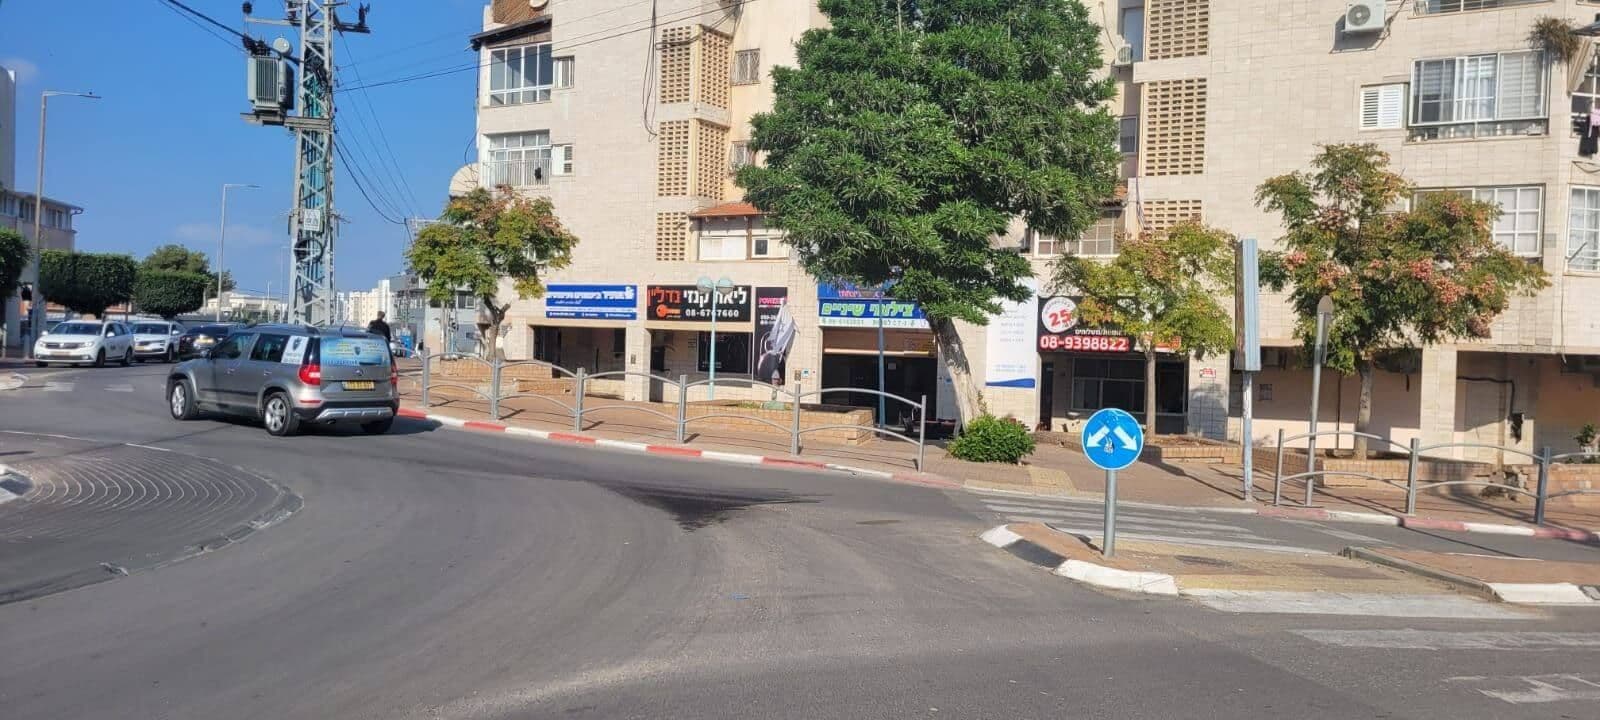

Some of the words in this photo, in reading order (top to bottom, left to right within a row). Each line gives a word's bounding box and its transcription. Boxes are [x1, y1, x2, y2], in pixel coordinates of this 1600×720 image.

[820, 302, 866, 317] שיניים
[1049, 307, 1073, 327] 25
[1040, 335, 1127, 351] 08-9398822
